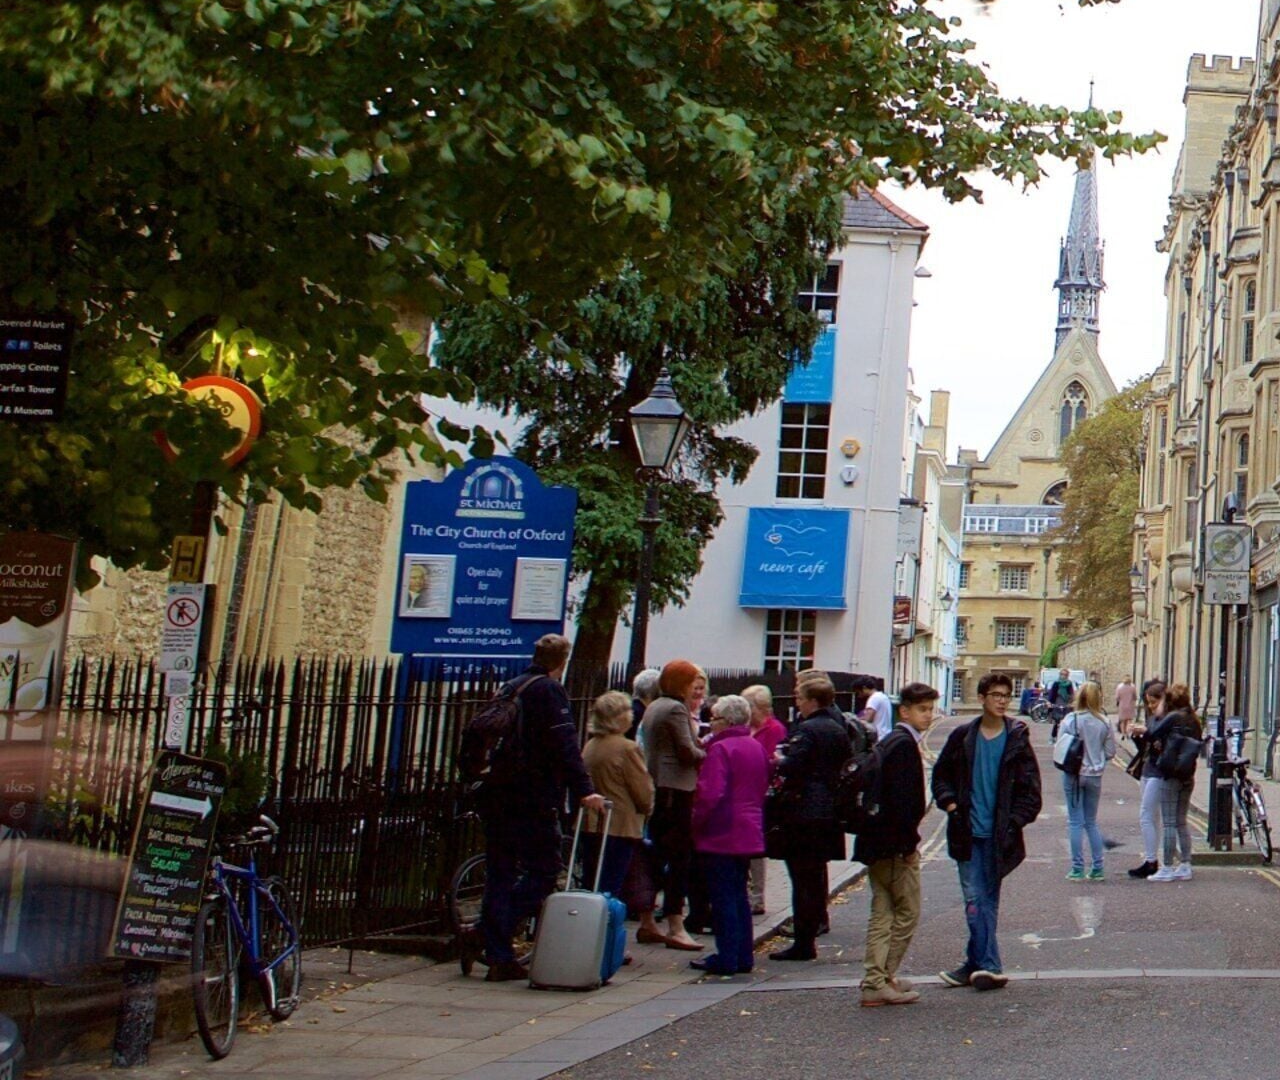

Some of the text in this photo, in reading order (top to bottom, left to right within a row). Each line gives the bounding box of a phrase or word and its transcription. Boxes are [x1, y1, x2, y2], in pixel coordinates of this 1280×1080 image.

[32, 320, 65, 330] Market
[33, 341, 62, 351] Toilets
[28, 363, 60, 373] Centre
[28, 385, 56, 394] Tower
[14, 406, 54, 416] Museum
[411, 524, 566, 541] The City Church of Oxford
[458, 541, 484, 549] Church
[491, 542, 517, 551] England
[467, 566, 503, 579] Open daily
[760, 560, 829, 581] news café
[478, 581, 489, 591] for
[456, 595, 509, 607] quiet and prayer
